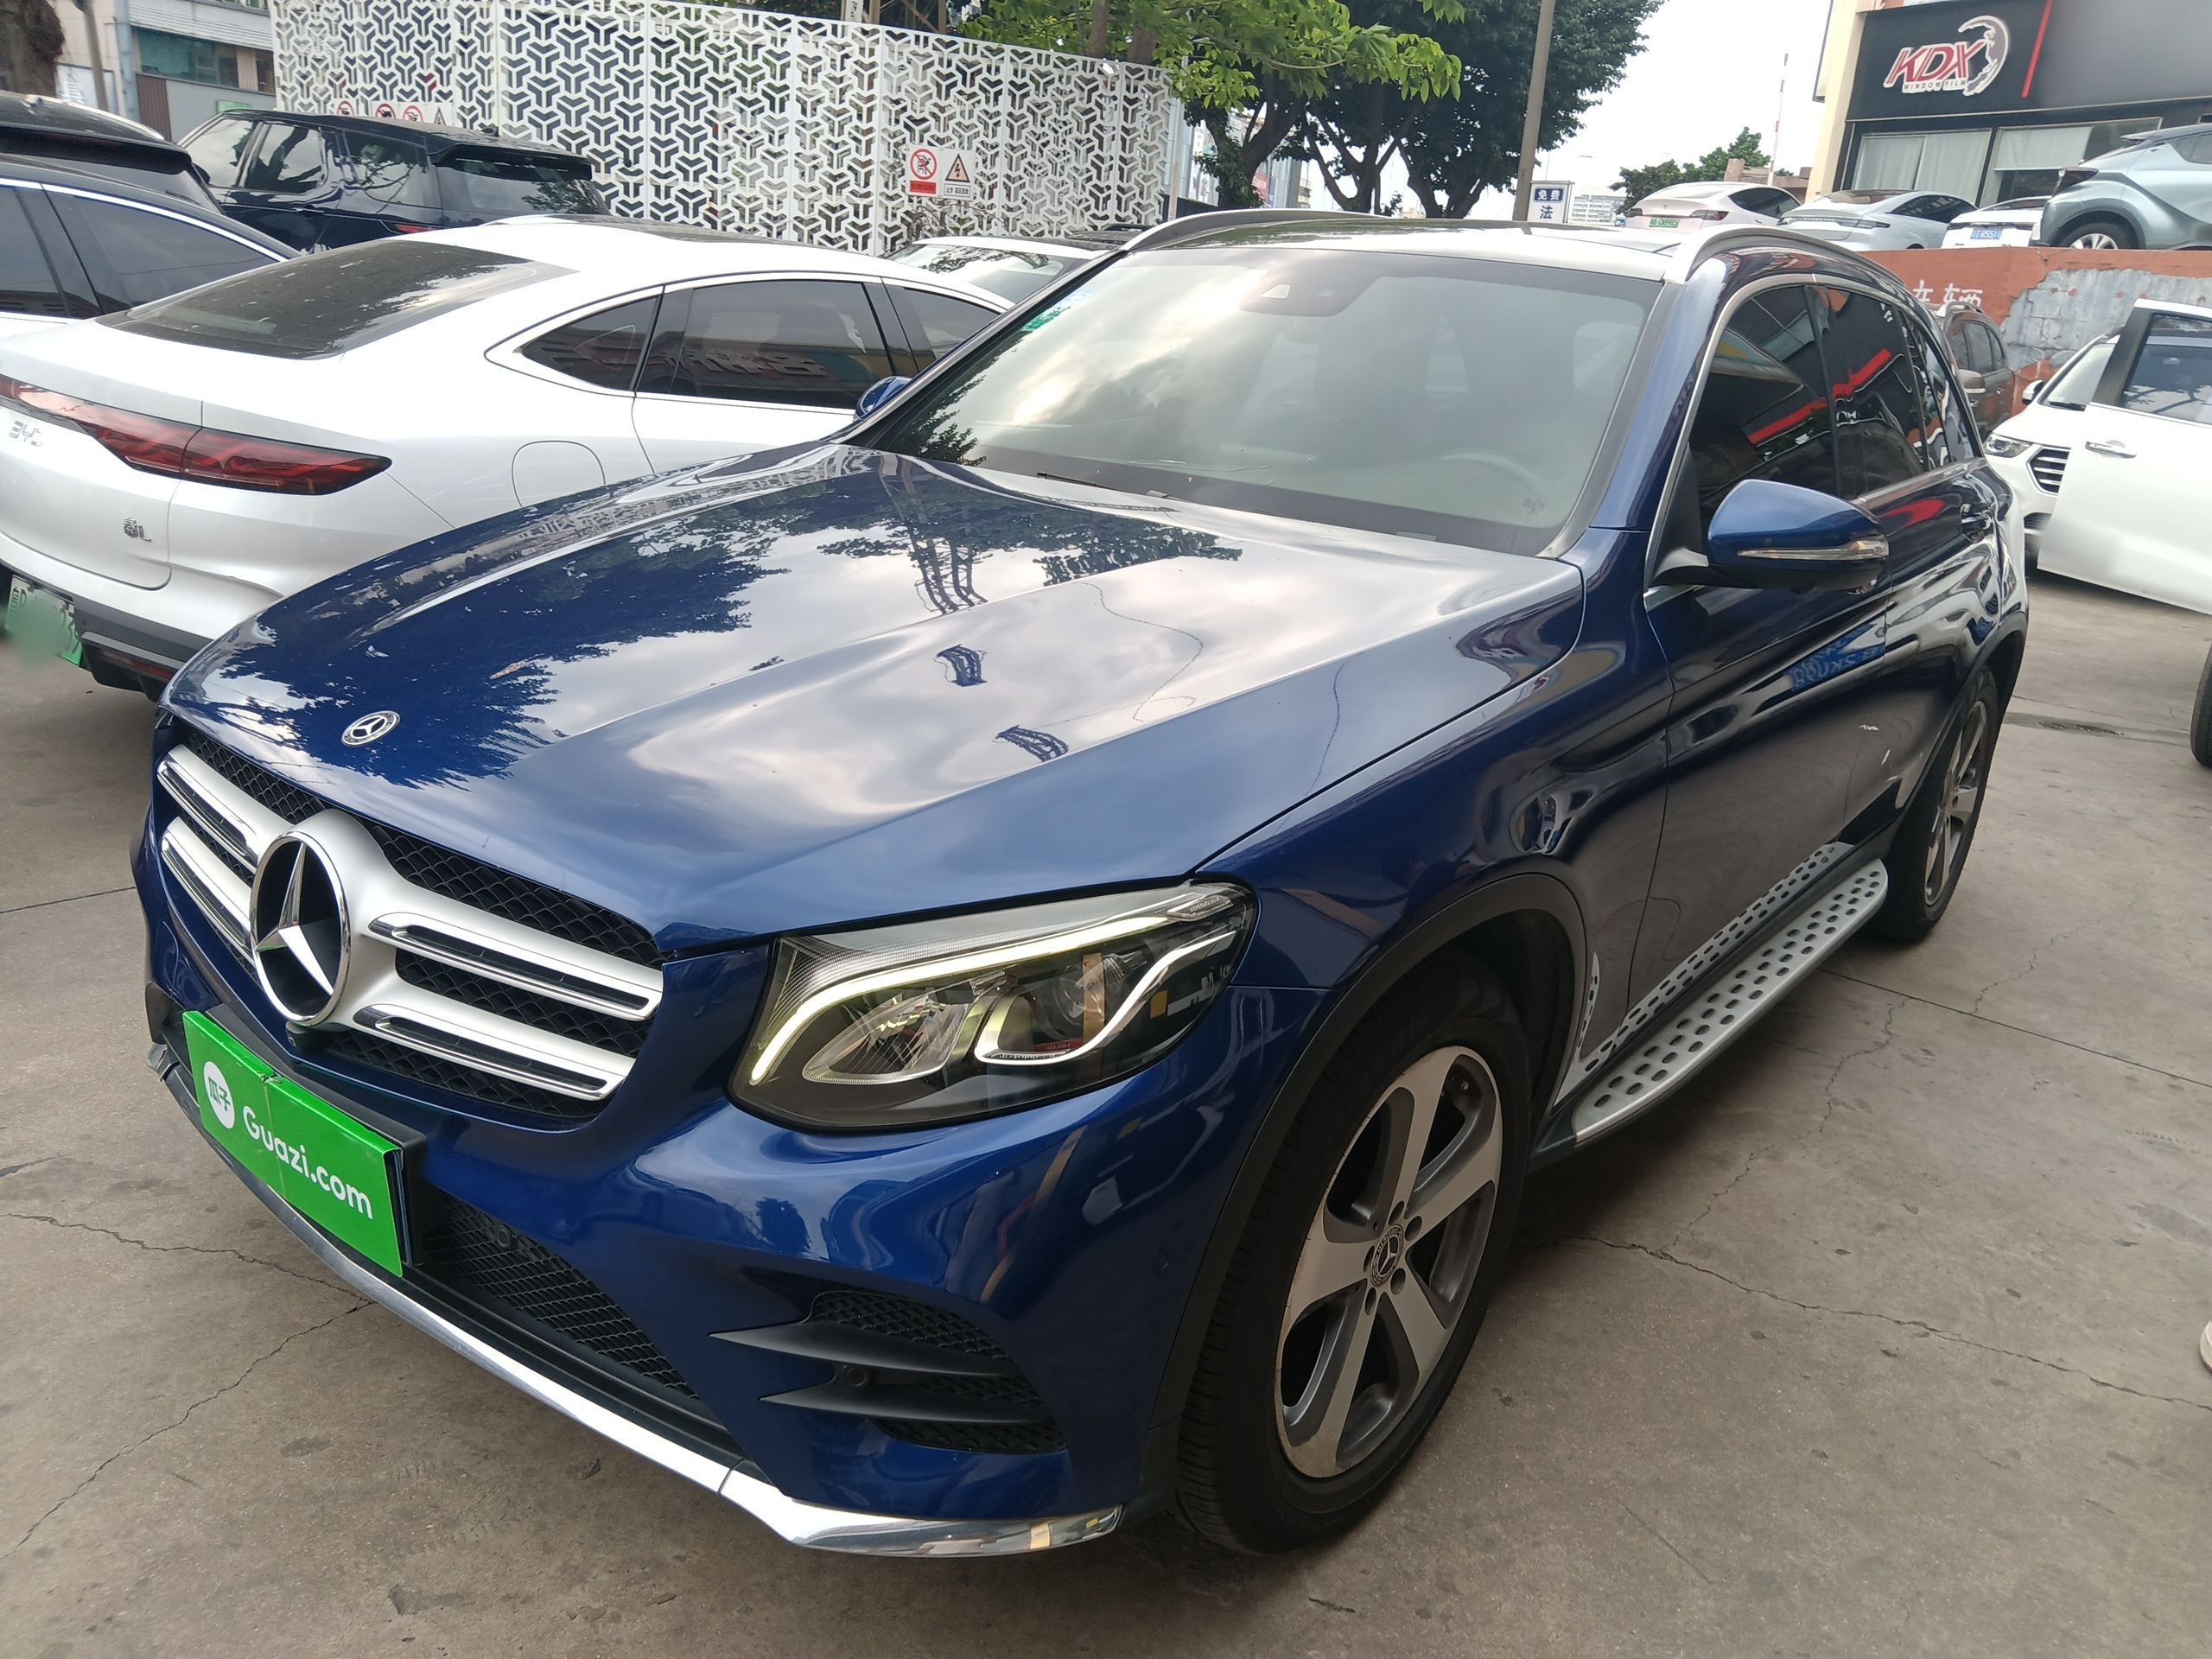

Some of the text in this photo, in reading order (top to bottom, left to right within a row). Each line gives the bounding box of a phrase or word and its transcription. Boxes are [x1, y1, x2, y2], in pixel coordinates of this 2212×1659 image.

[1886, 41, 1986, 86] KDX
[1904, 80, 1941, 90] WINDOW
[1537, 189, 1560, 200] 免费
[1539, 205, 1554, 219] 法
[207, 1077, 232, 1112] 瓜子
[243, 1105, 373, 1220] Guazi.com
